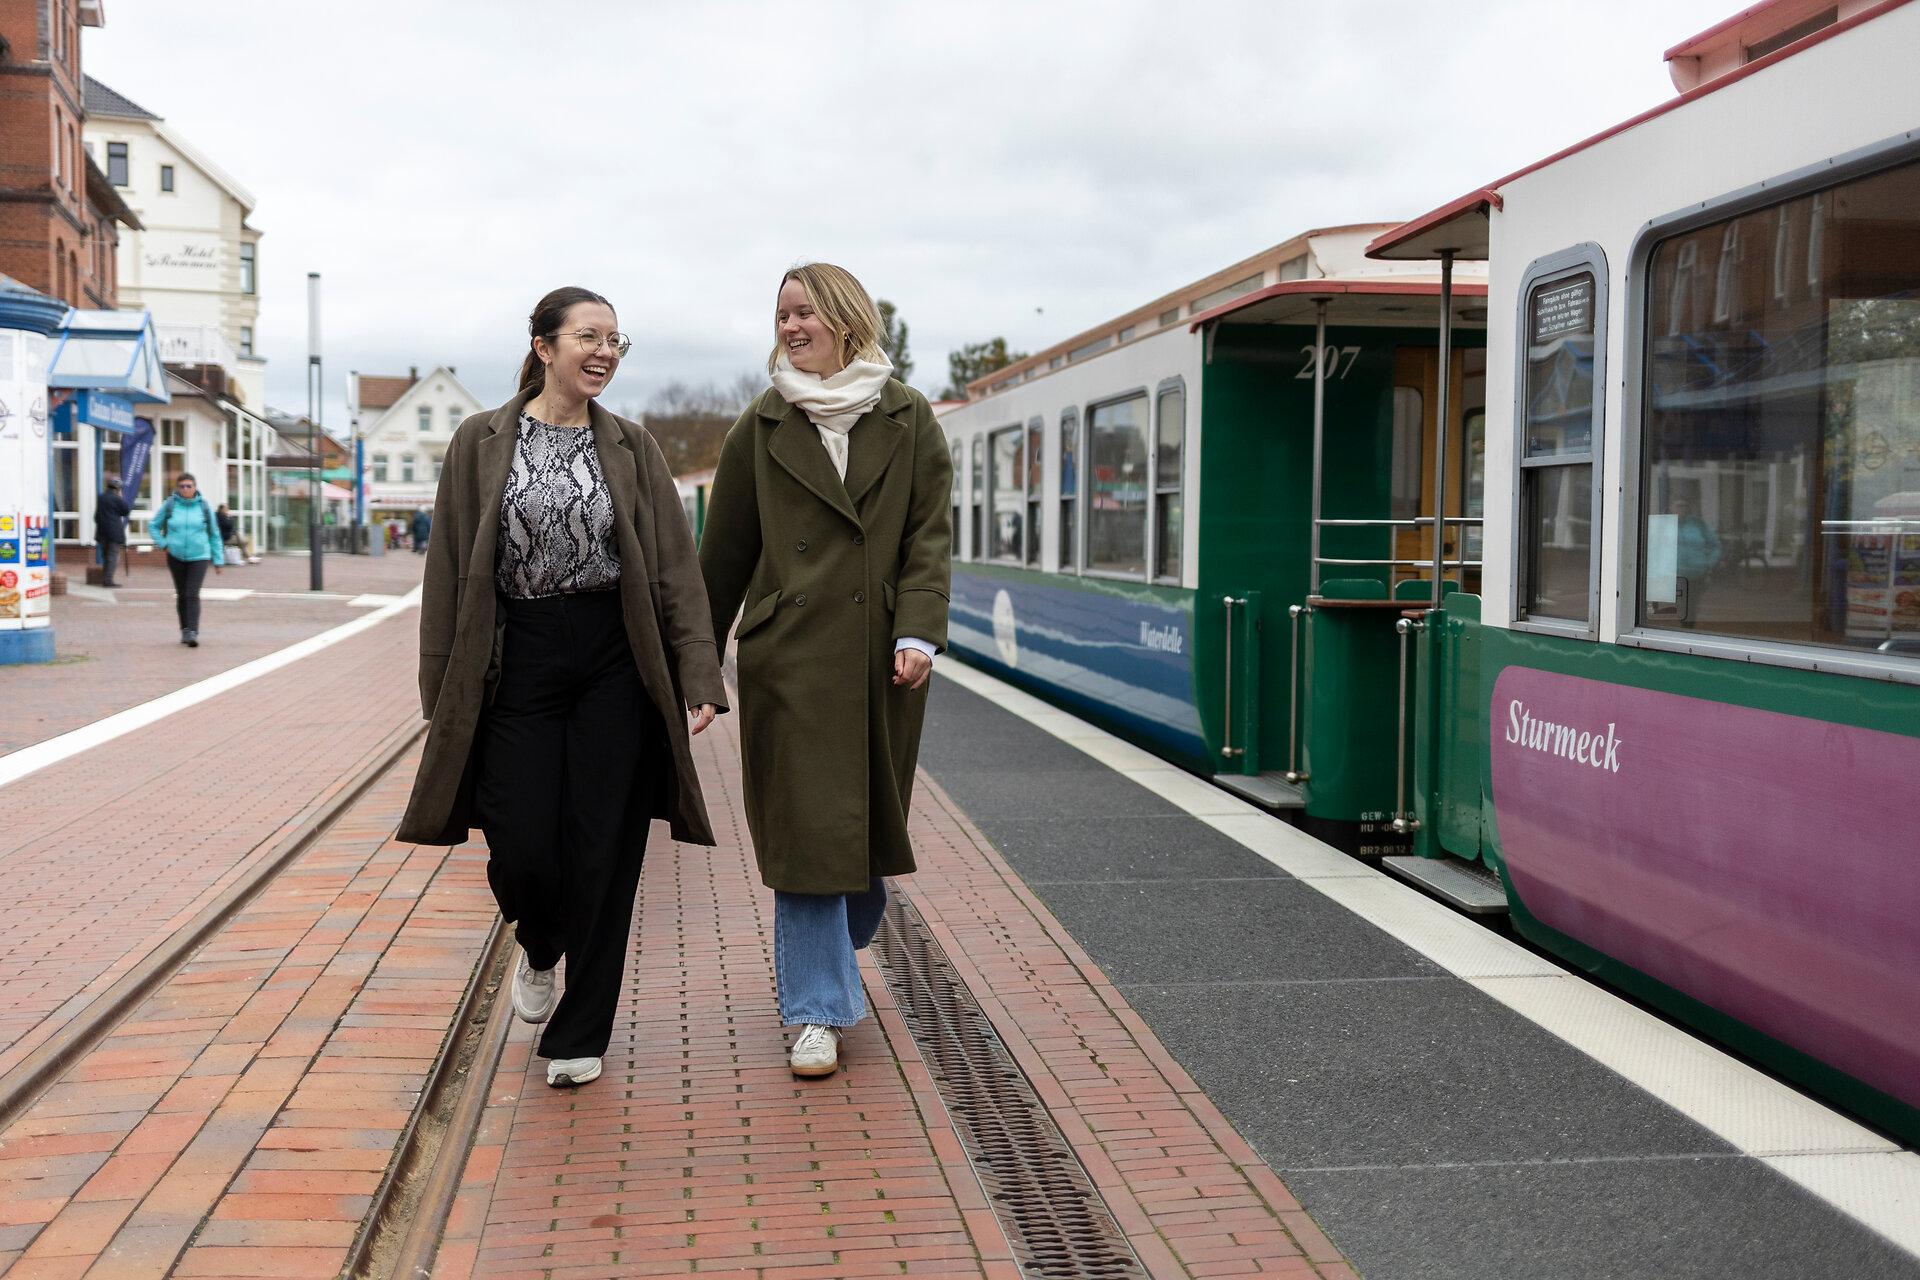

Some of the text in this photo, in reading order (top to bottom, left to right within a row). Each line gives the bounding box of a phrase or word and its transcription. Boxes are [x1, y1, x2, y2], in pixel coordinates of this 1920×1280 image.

[180, 244, 215, 257] Hotel
[1295, 344, 1362, 380] 207
[1140, 620, 1183, 654] Waterdelle
[1506, 699, 1623, 773] Sturmeck
